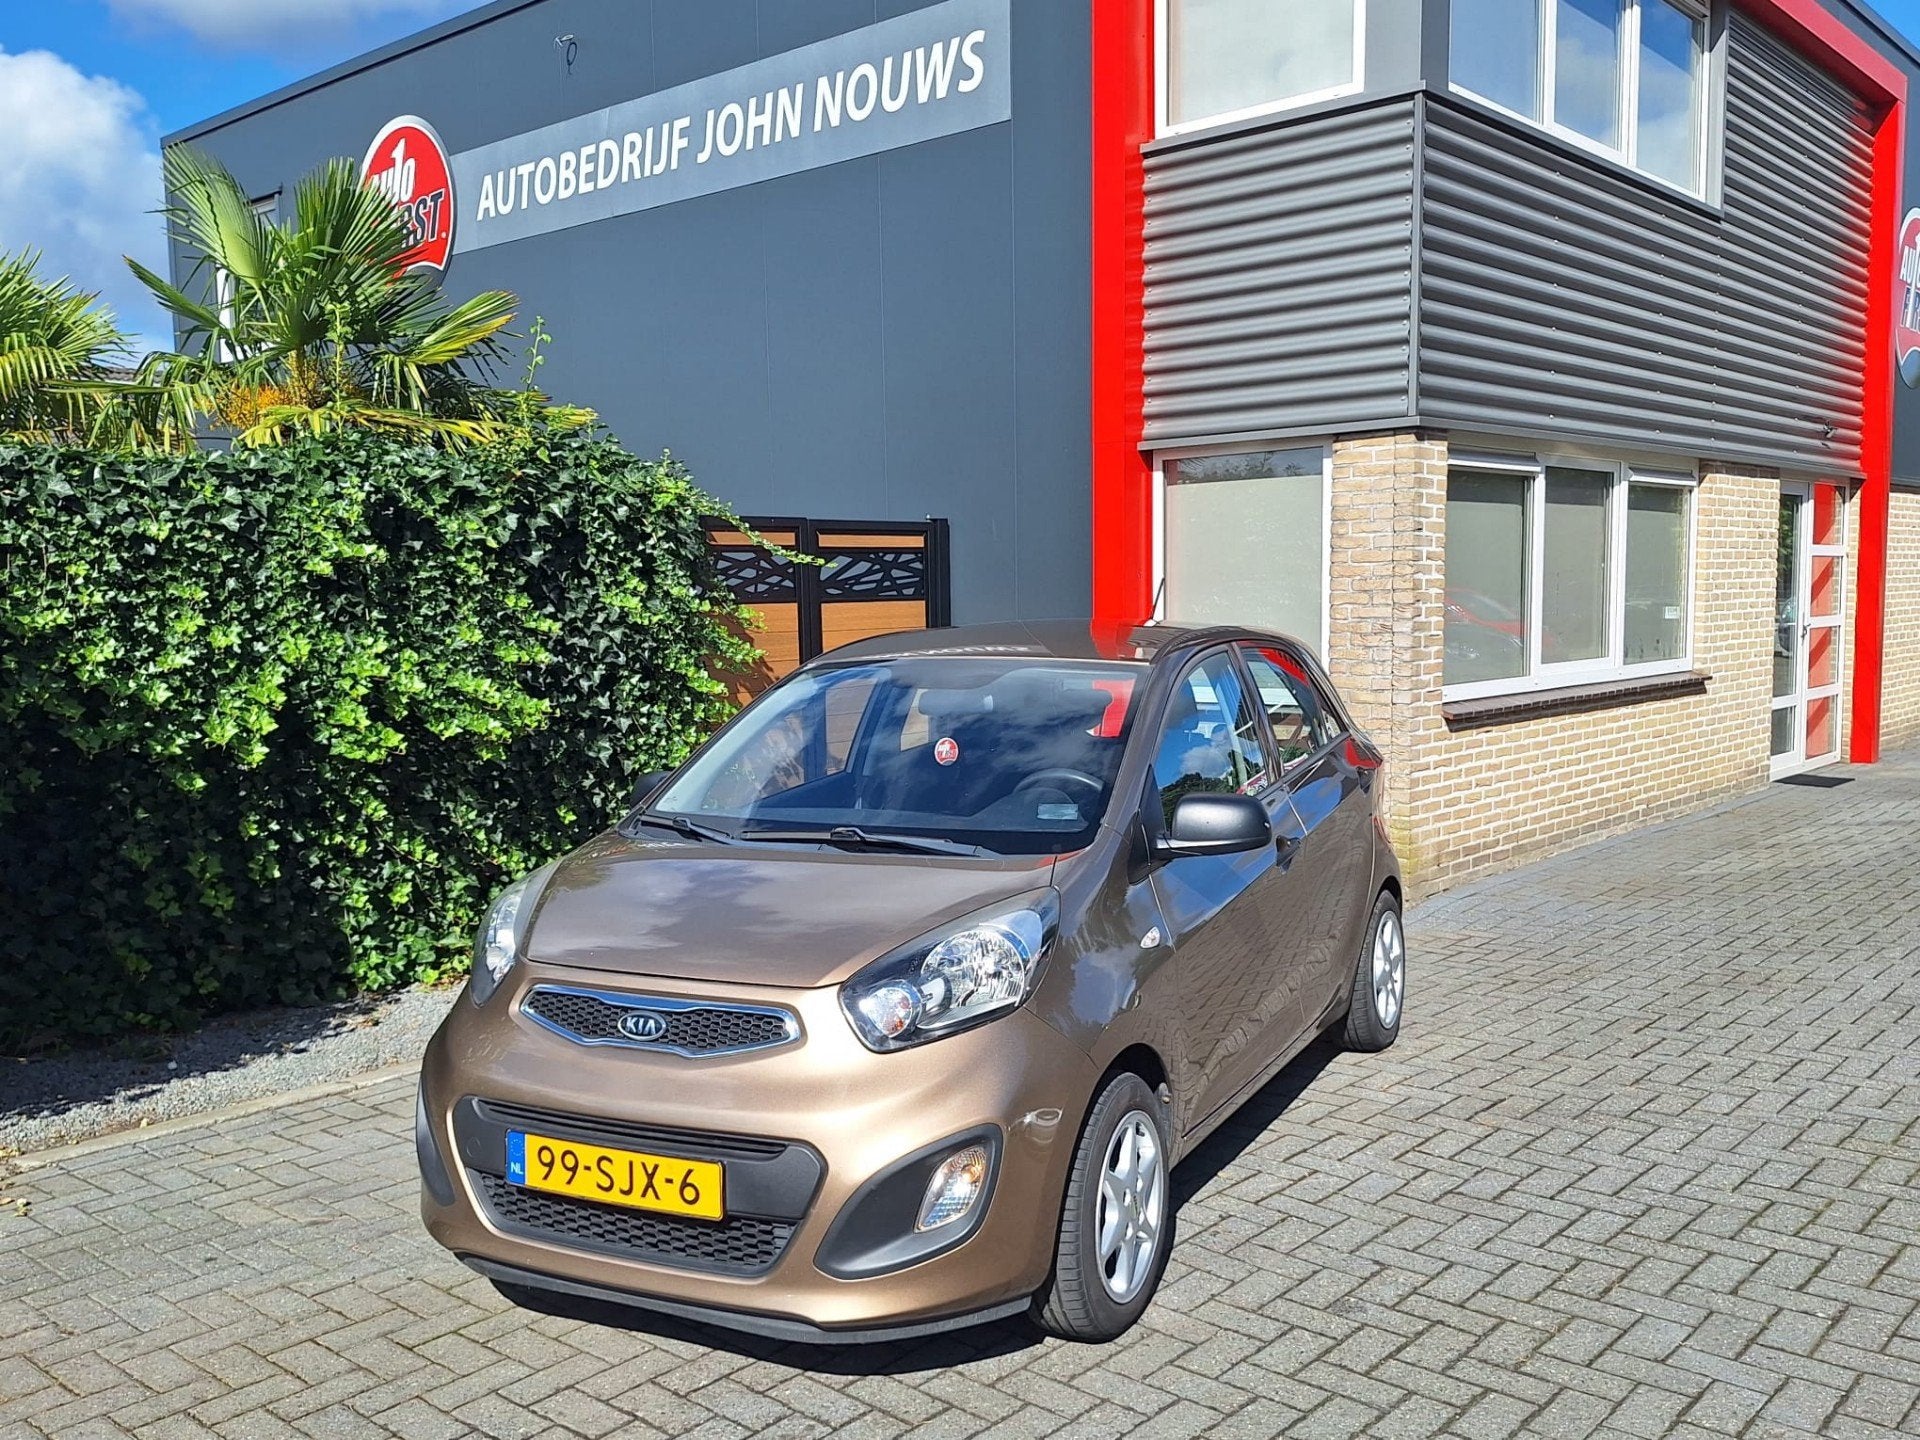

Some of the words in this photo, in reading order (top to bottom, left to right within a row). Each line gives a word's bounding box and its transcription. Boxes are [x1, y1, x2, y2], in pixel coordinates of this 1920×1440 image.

[476, 116, 691, 221] AUTOBEDRIJF
[696, 83, 804, 164] JOHN
[813, 39, 986, 132] NOUWS
[626, 1016, 657, 1035] KIA
[510, 1161, 524, 1176] NL
[536, 1145, 700, 1206] 99-SJX-6
